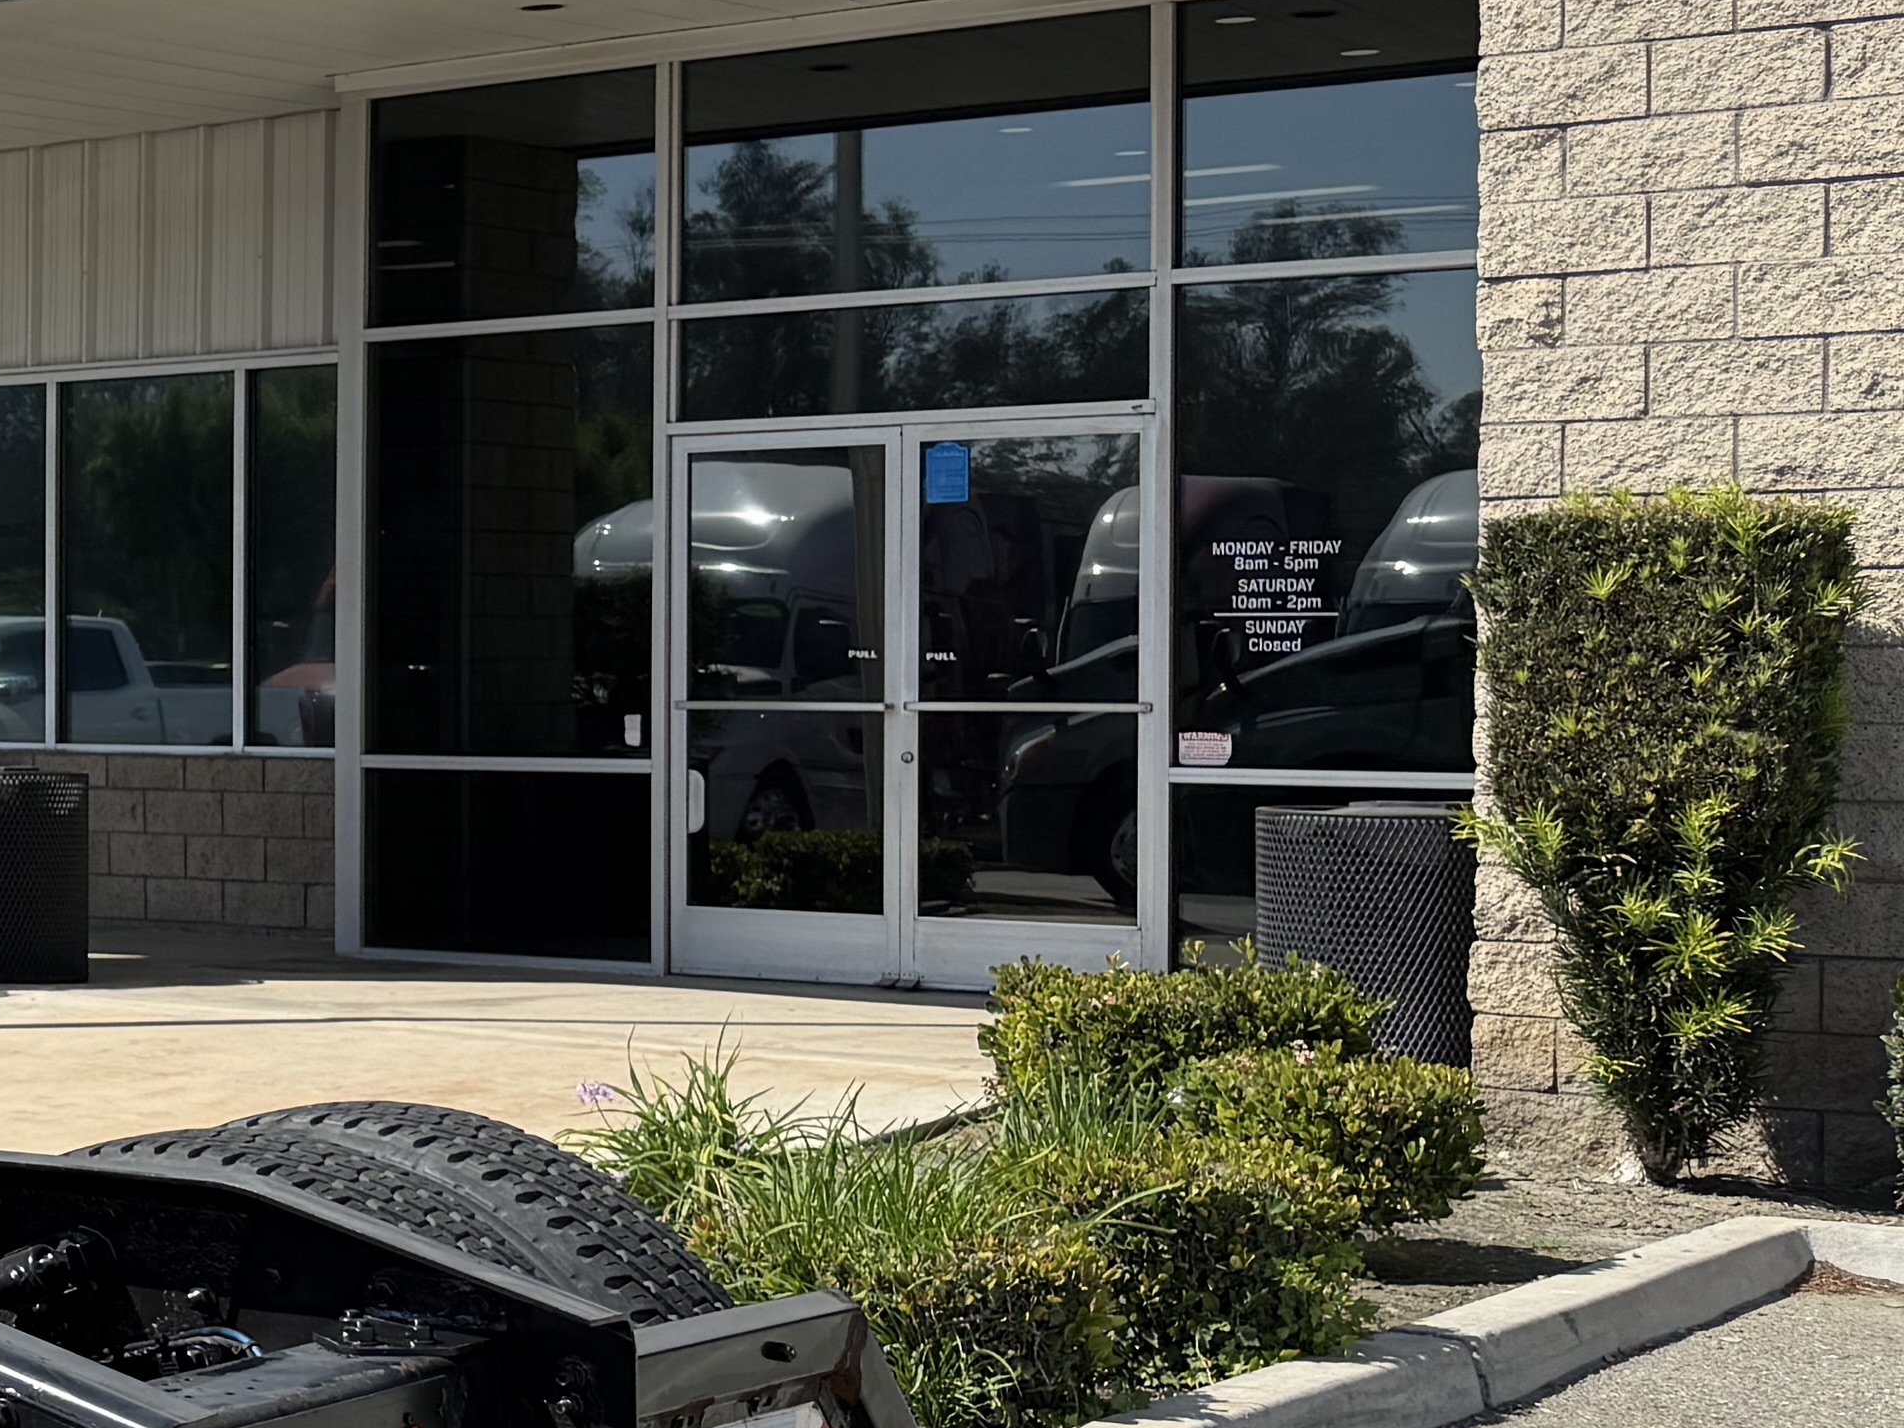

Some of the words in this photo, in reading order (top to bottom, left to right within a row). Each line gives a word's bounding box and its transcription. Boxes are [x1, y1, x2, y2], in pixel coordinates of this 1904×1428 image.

[1212, 541, 1274, 556] MONDAY
[1289, 539, 1342, 555] FRIDAY
[1234, 557, 1269, 571] 8am
[1283, 557, 1319, 573] 5pm
[1238, 578, 1315, 593] SATURDAY
[1231, 595, 1272, 610] 10am
[1286, 595, 1322, 611] 2pm
[1245, 620, 1306, 634] SUNDAY
[1248, 638, 1302, 652] Closed
[848, 649, 878, 659] PULL
[925, 651, 957, 661] PULL
